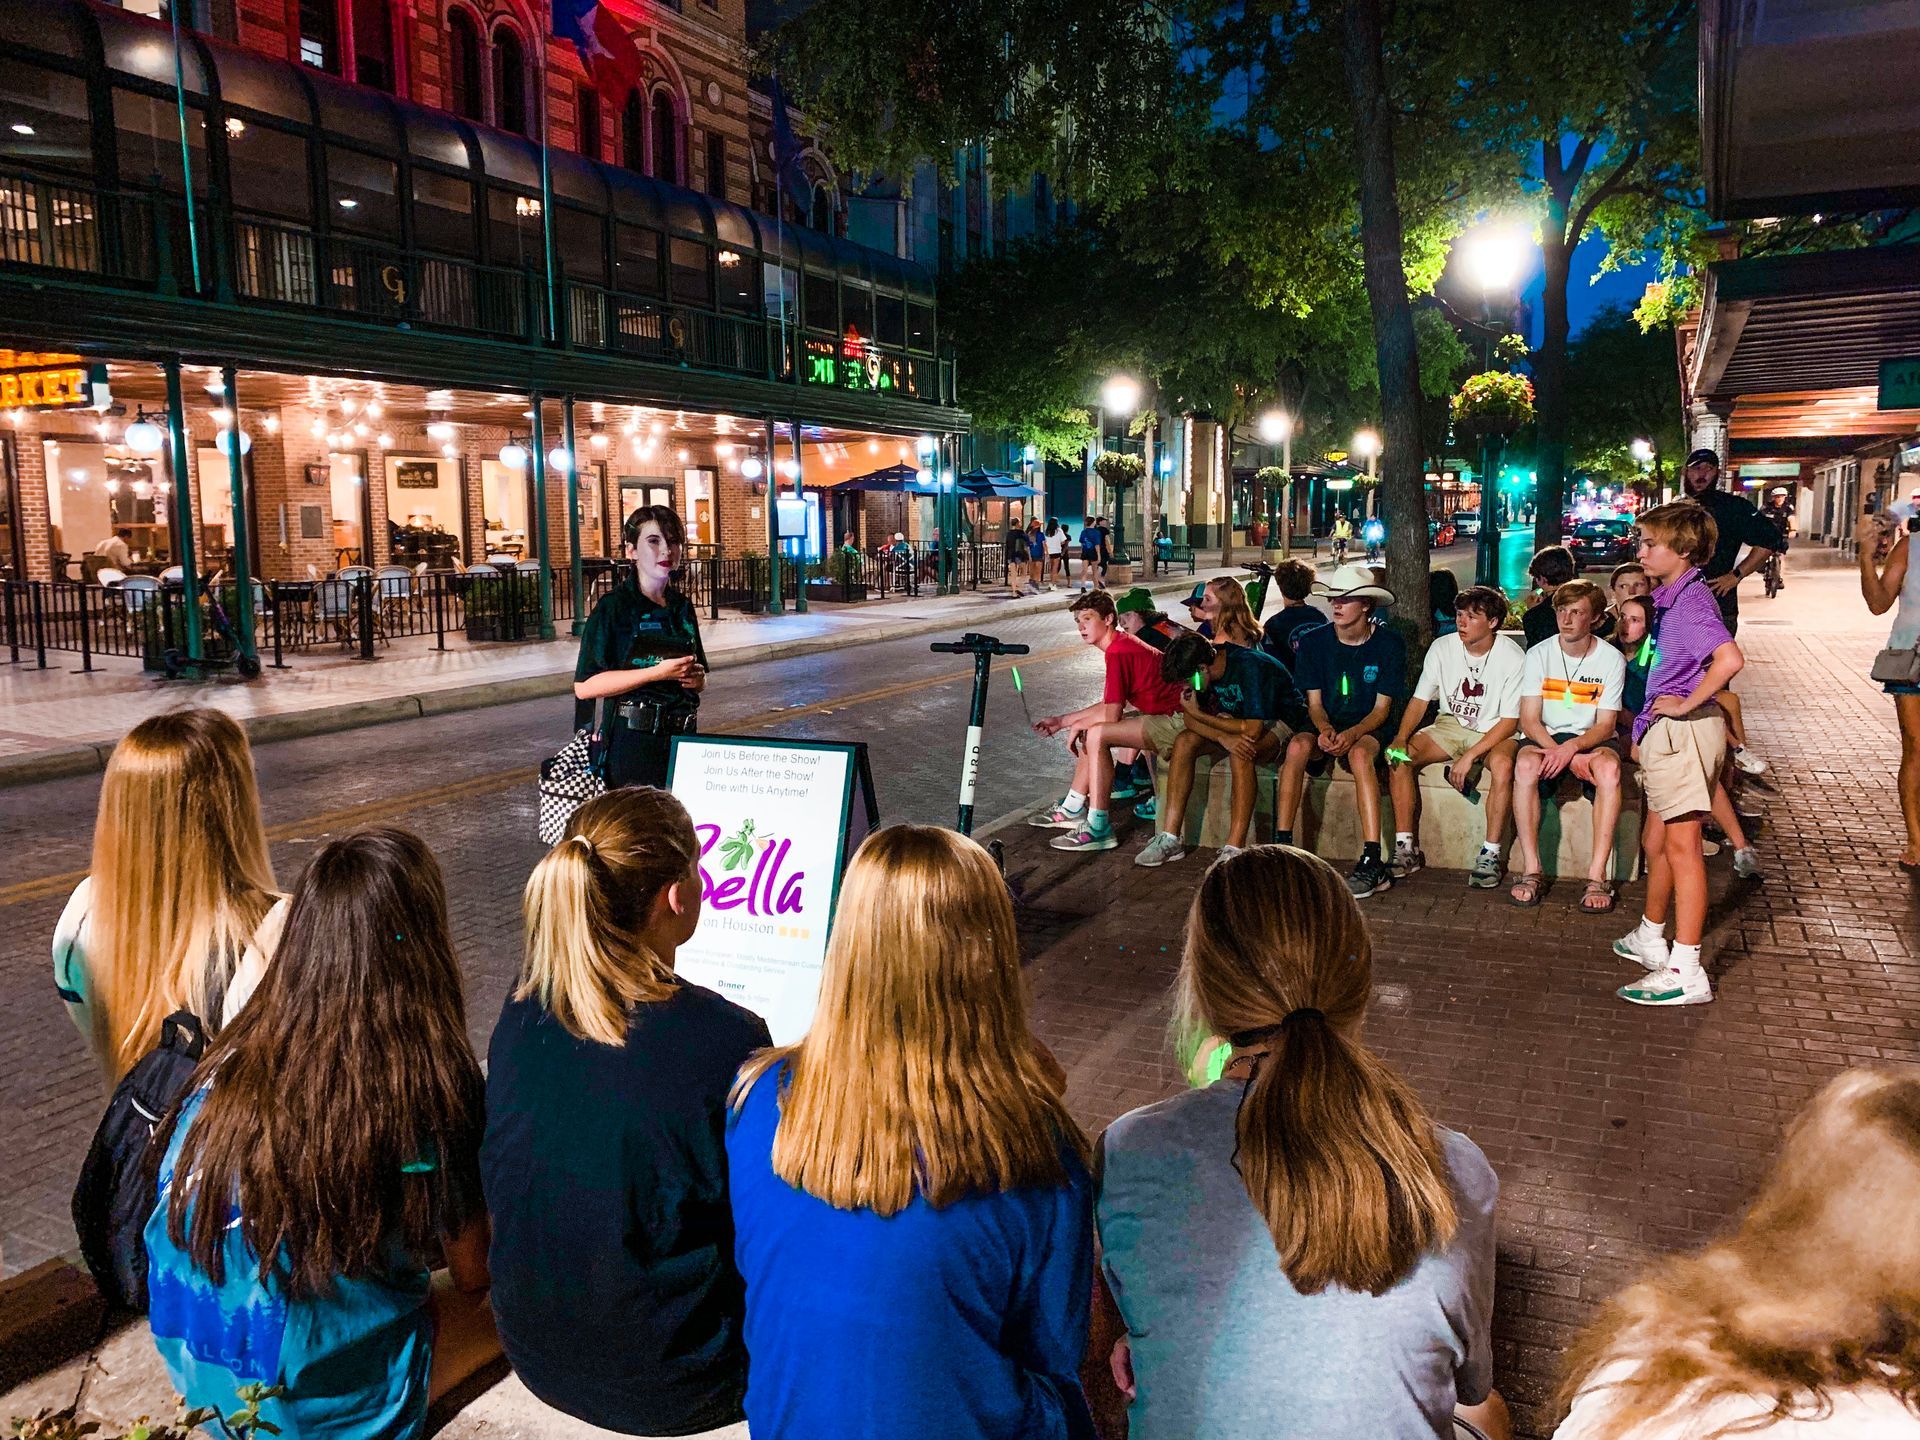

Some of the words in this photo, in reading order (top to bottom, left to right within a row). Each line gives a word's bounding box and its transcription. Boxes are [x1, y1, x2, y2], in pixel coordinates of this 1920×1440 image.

[701, 749, 720, 759] Join
[723, 750, 736, 760] Us
[739, 751, 770, 762] Before
[772, 752, 788, 763] the
[790, 754, 821, 765] Show!
[704, 765, 723, 775] Join
[726, 766, 738, 776] Us
[741, 767, 763, 778] After
[766, 769, 781, 779] the
[784, 771, 814, 781] Show!
[968, 746, 980, 787] BIRD
[705, 781, 727, 792] Dine
[730, 783, 748, 793] with
[751, 784, 764, 794] Us
[766, 785, 809, 799] Anytime!
[703, 918, 718, 929] on
[722, 917, 774, 935] Houston
[718, 980, 745, 990] Dinner
